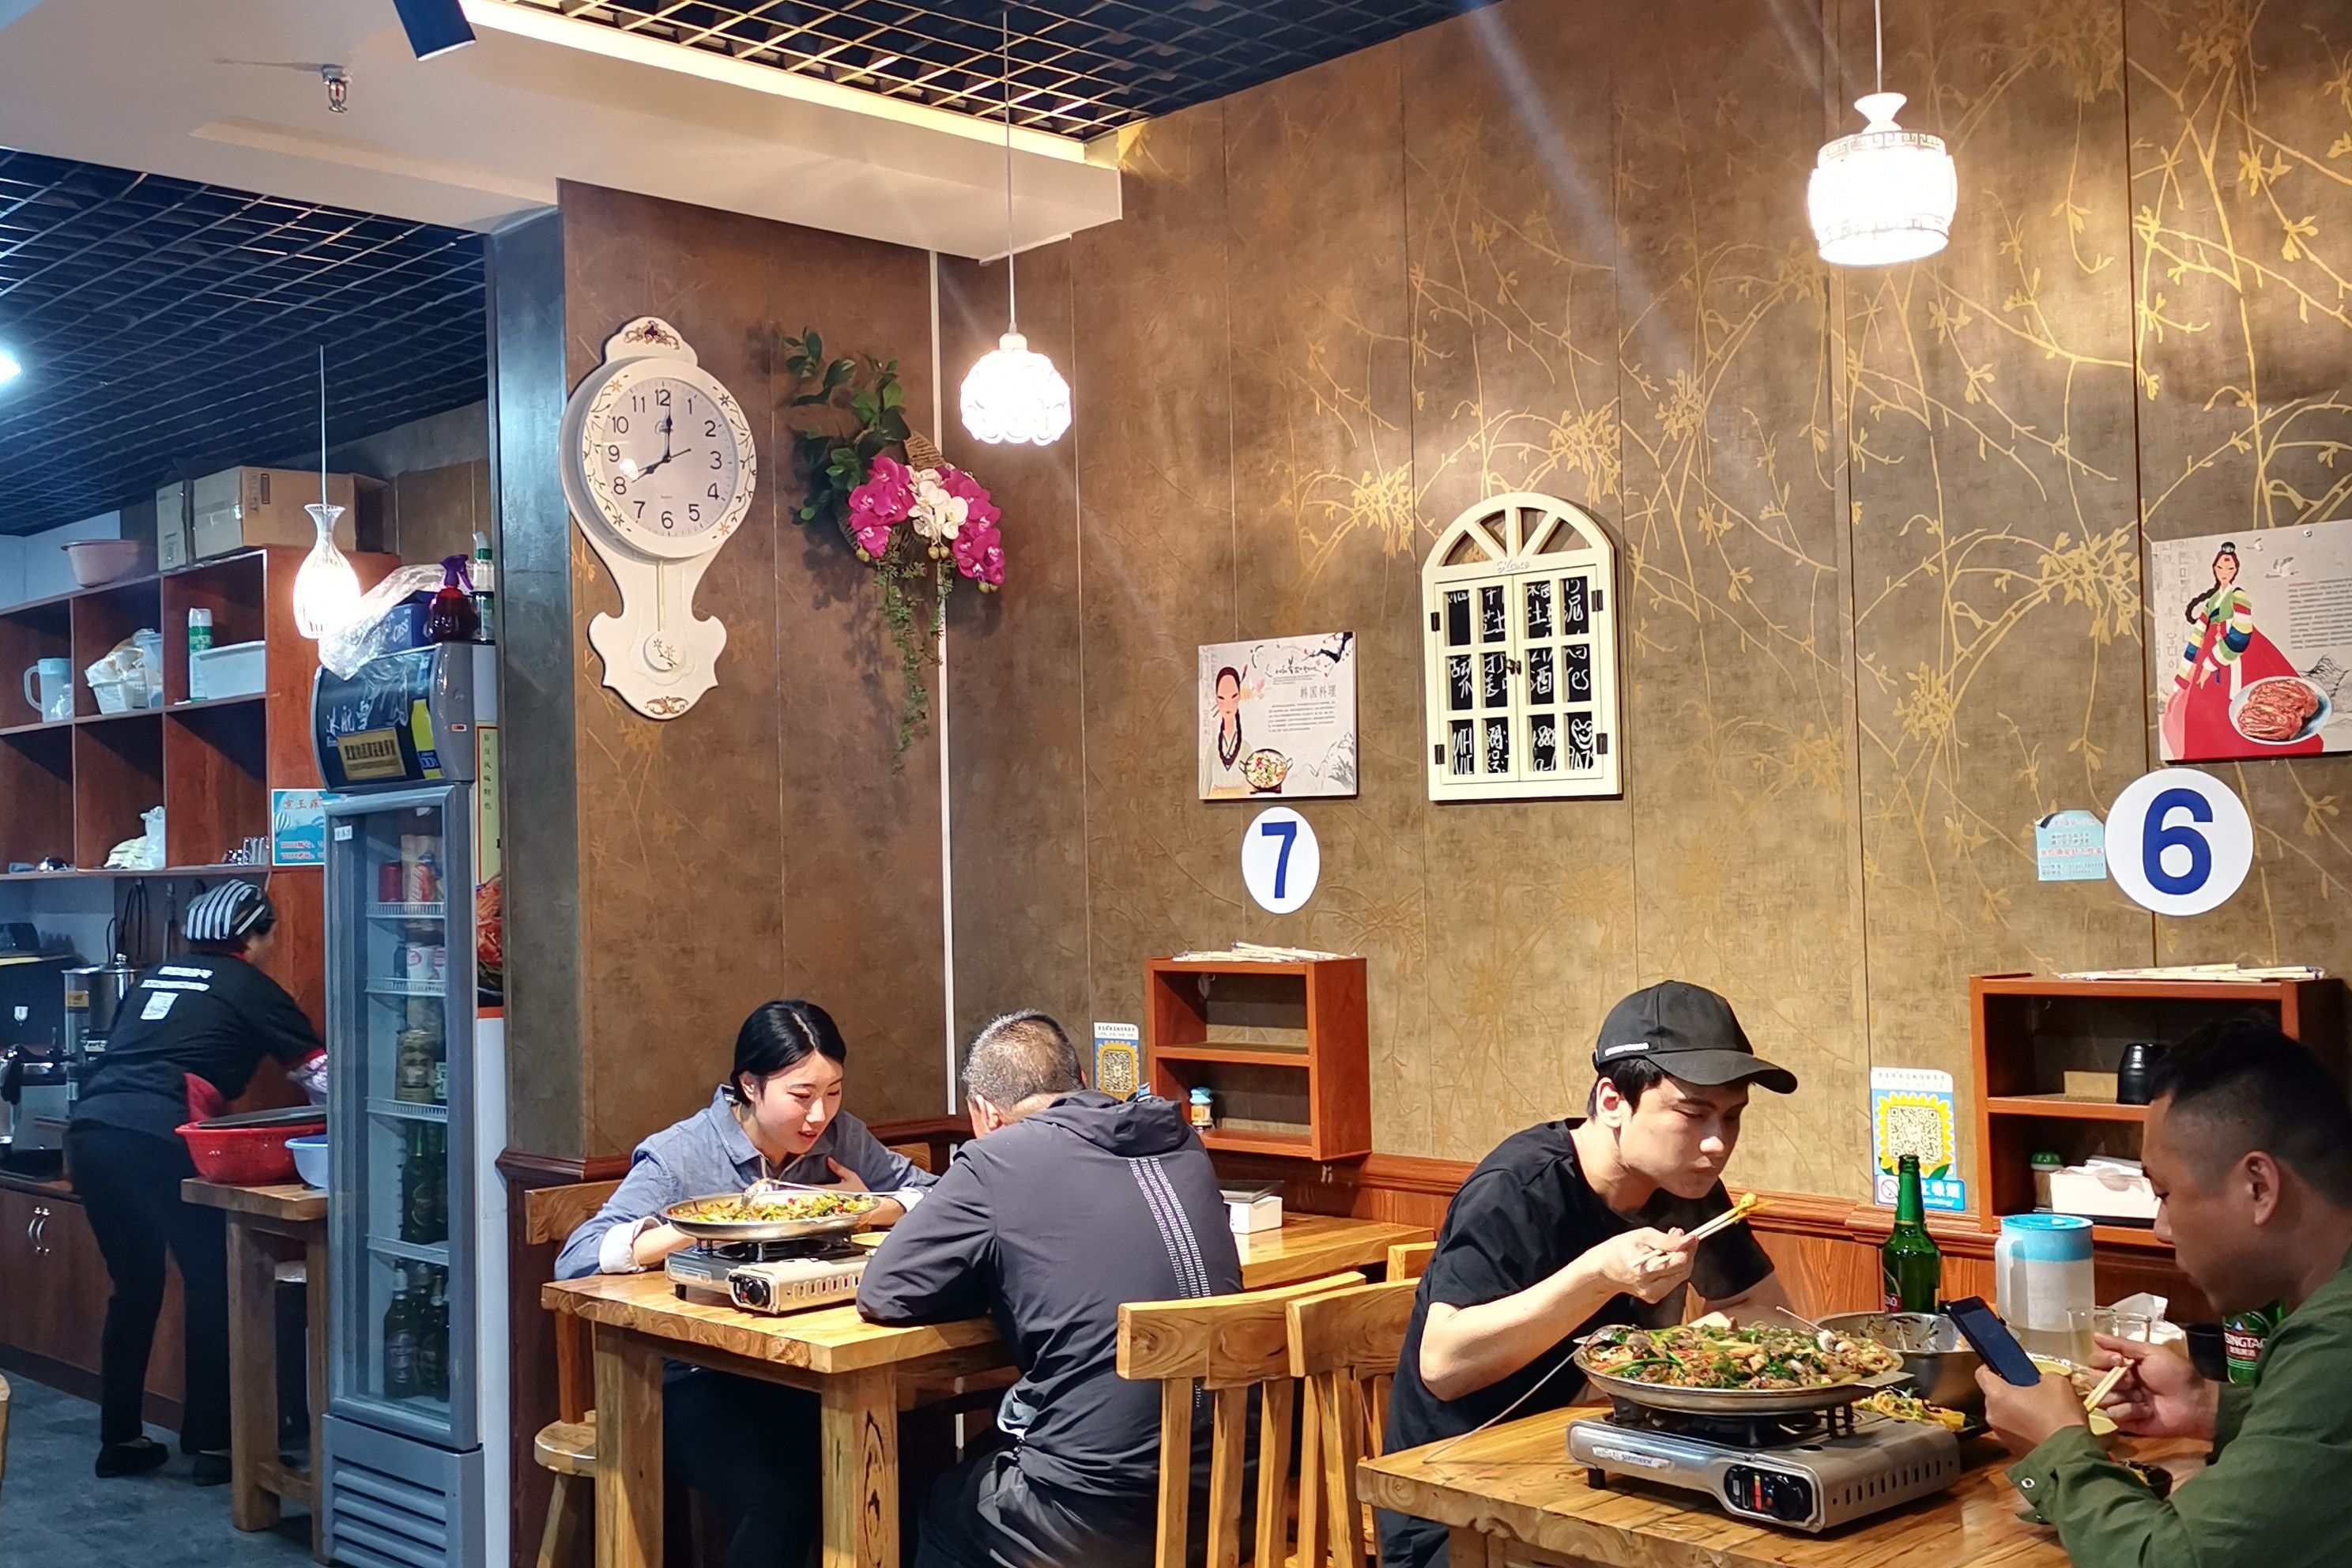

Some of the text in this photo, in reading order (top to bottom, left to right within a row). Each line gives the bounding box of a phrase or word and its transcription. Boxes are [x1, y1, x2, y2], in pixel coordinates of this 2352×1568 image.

[632, 395, 645, 413] 11
[654, 389, 670, 406] 12
[688, 398, 693, 415] 1
[612, 416, 629, 434] 10
[704, 420, 717, 437] 2
[608, 444, 620, 462] 9
[710, 450, 722, 470] 3
[613, 476, 627, 496] 8
[707, 482, 720, 500] 4
[633, 500, 646, 519] 7
[688, 503, 701, 522] 5
[661, 511, 673, 530] 6
[1299, 684, 1337, 699] 韩国料理
[2142, 787, 2214, 895] 6
[1261, 821, 1297, 899] 7
